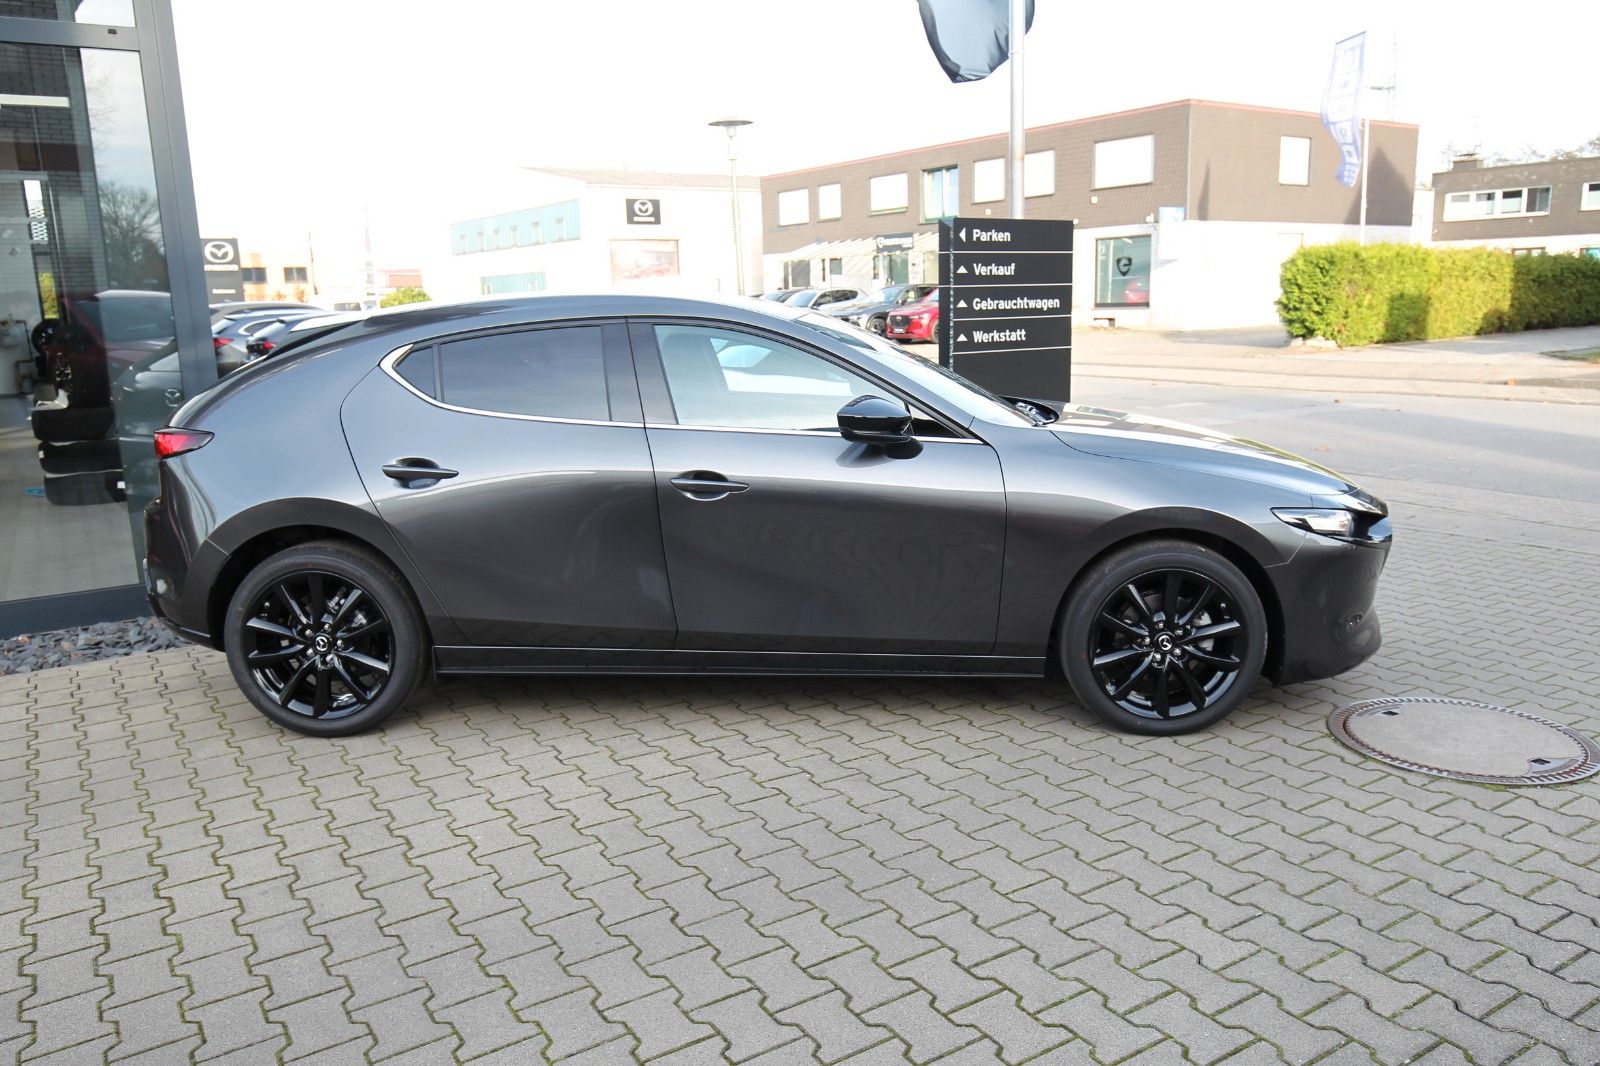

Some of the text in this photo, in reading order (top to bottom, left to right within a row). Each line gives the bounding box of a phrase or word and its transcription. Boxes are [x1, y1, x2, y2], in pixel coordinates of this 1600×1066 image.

[972, 229, 1011, 242] Parken
[973, 263, 1016, 276] Verkauf
[972, 297, 1060, 311] Gebrauchtwagen
[973, 329, 1026, 343] Werkstatt
